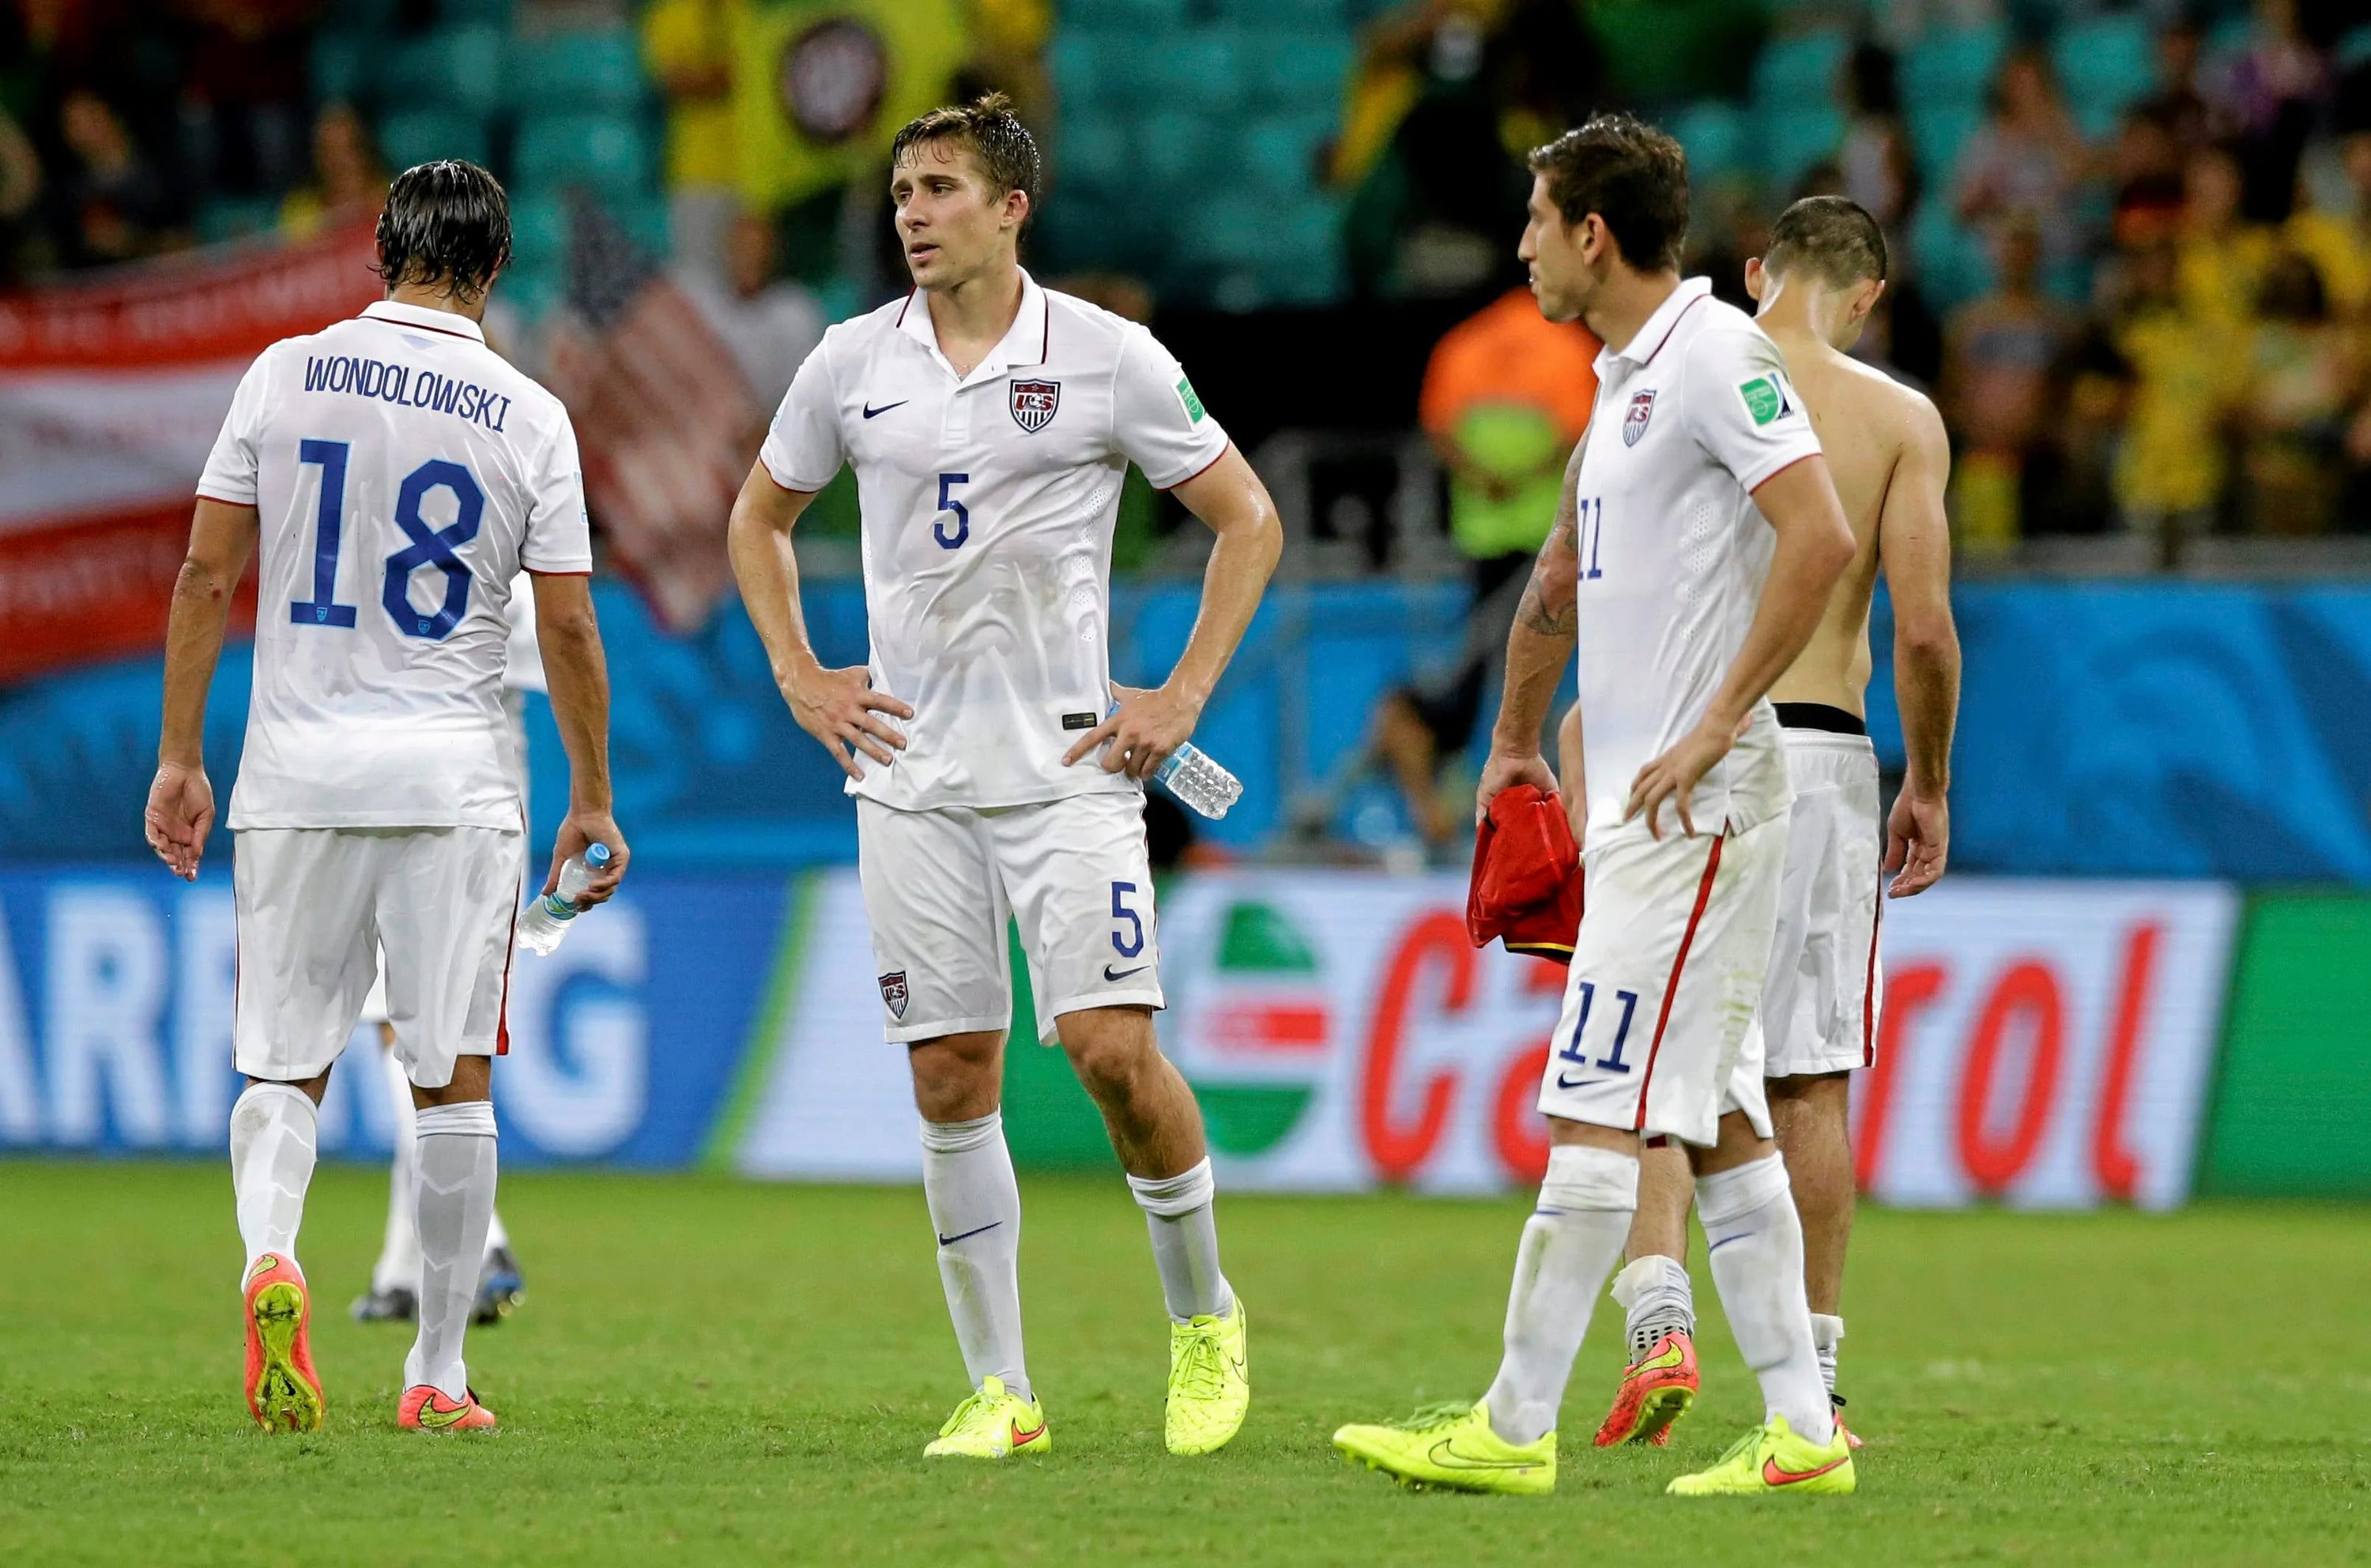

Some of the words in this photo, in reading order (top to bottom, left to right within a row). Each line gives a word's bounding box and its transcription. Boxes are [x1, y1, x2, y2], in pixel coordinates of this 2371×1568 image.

[304, 356, 511, 432] WONDOLOWSKI
[290, 438, 486, 642] 18
[933, 473, 970, 550] 5
[1578, 497, 1602, 580] 11
[1110, 881, 1144, 958] 5
[1361, 907, 2164, 1198] Carol
[1559, 982, 1638, 1073] 11
